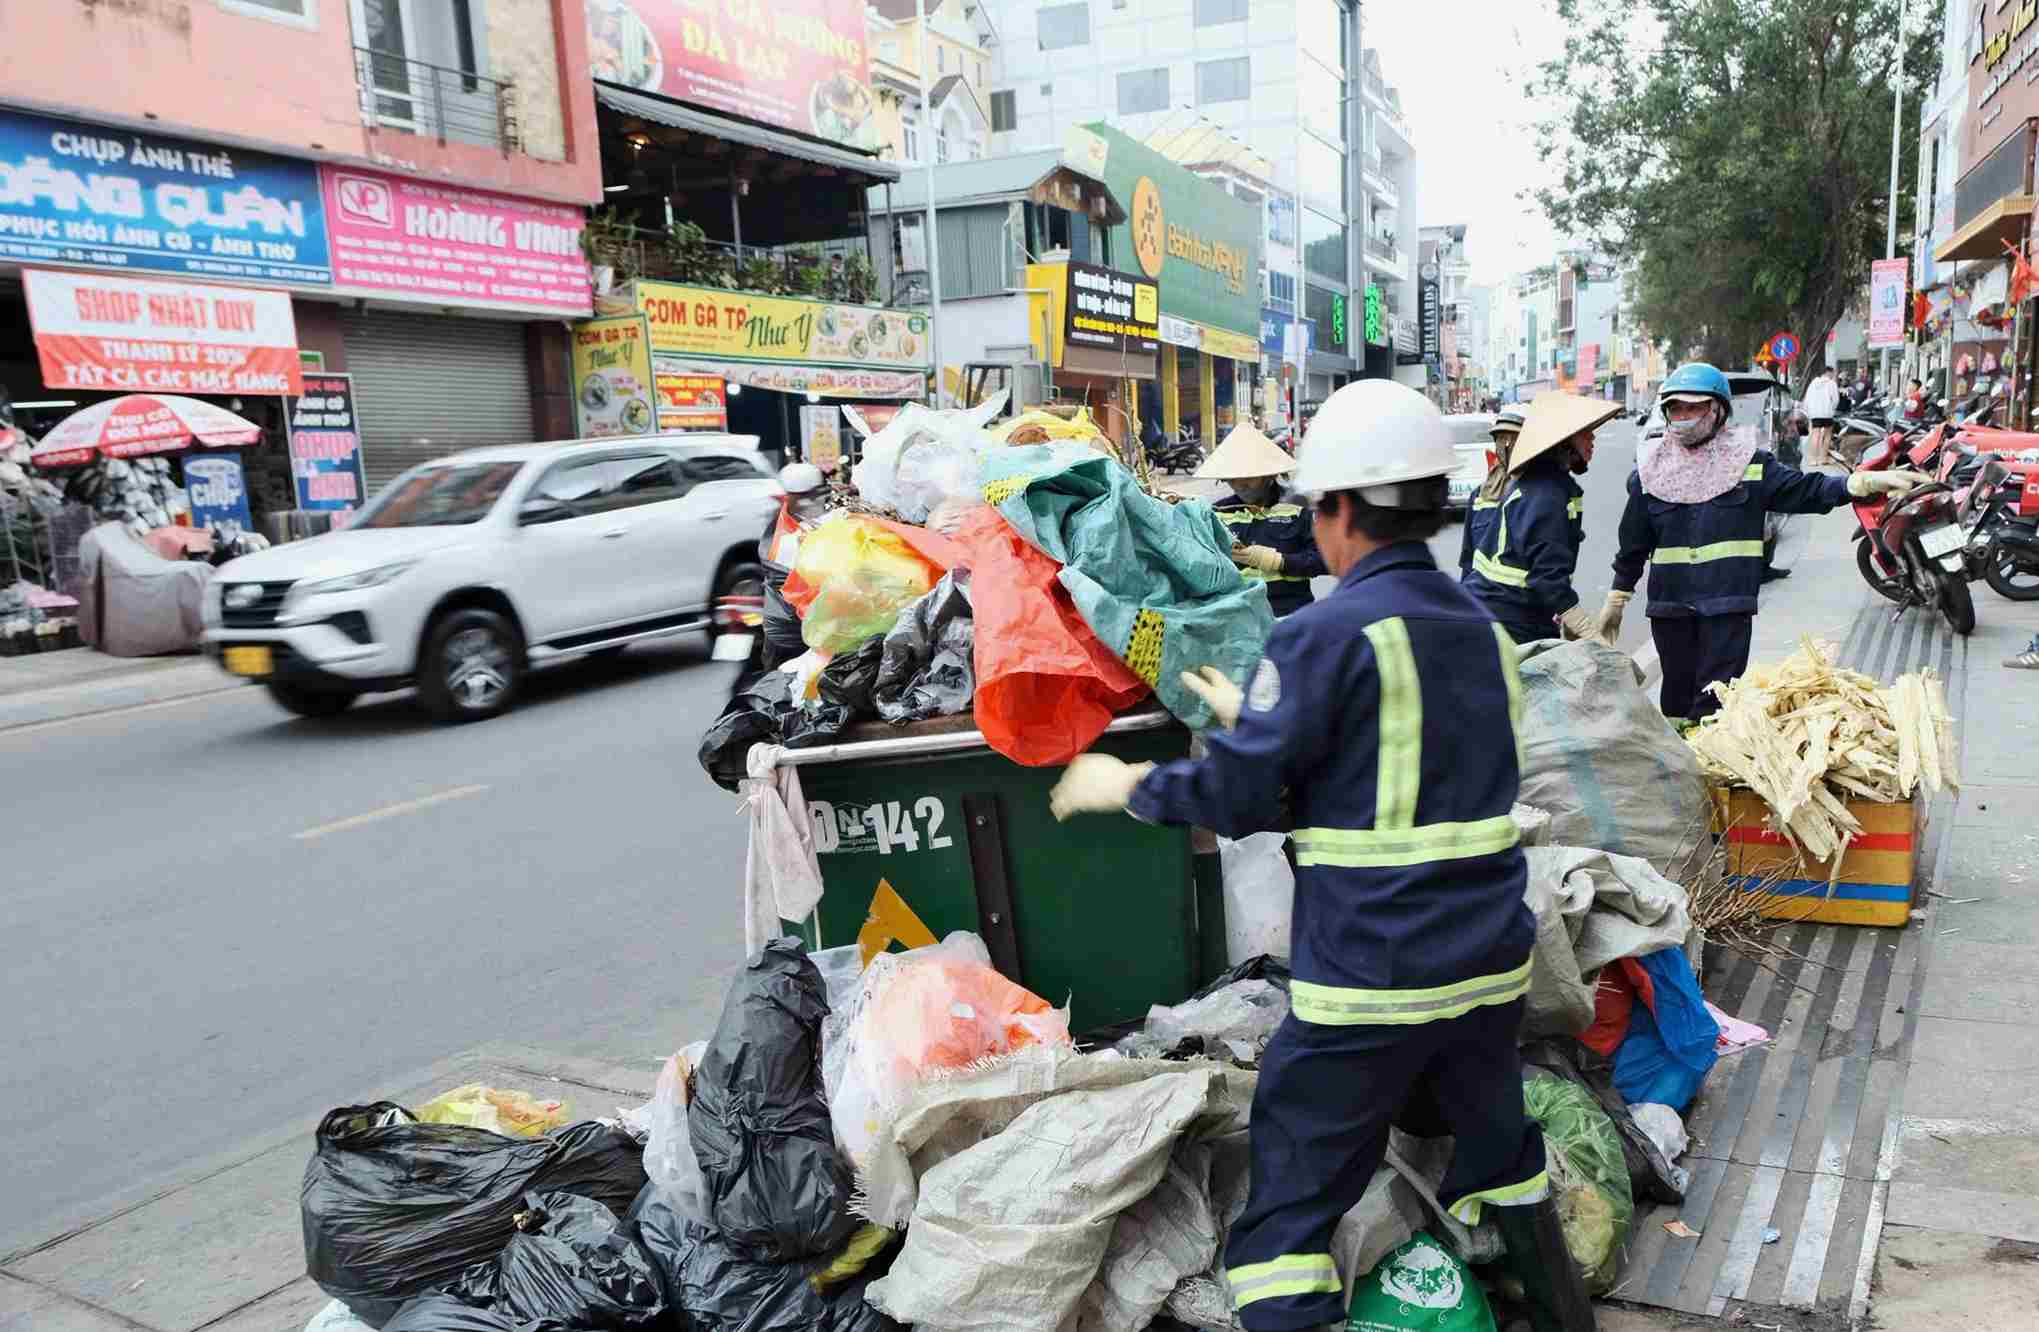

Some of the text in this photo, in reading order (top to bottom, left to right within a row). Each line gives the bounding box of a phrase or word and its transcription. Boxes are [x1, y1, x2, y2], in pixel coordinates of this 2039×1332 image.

[51, 132, 235, 179] CHỤP ẢNH THẺ
[156, 184, 306, 237] QUÂN
[405, 202, 507, 248] HOÀNG
[75, 287, 140, 322] SHOP
[215, 300, 256, 332] DUY
[694, 294, 718, 328] GÀ
[1424, 284, 1437, 353] BILLIARDS
[101, 340, 173, 361] THANH
[64, 364, 103, 385] TẤT
[110, 363, 142, 386] CẢ
[145, 365, 183, 387] CÁC
